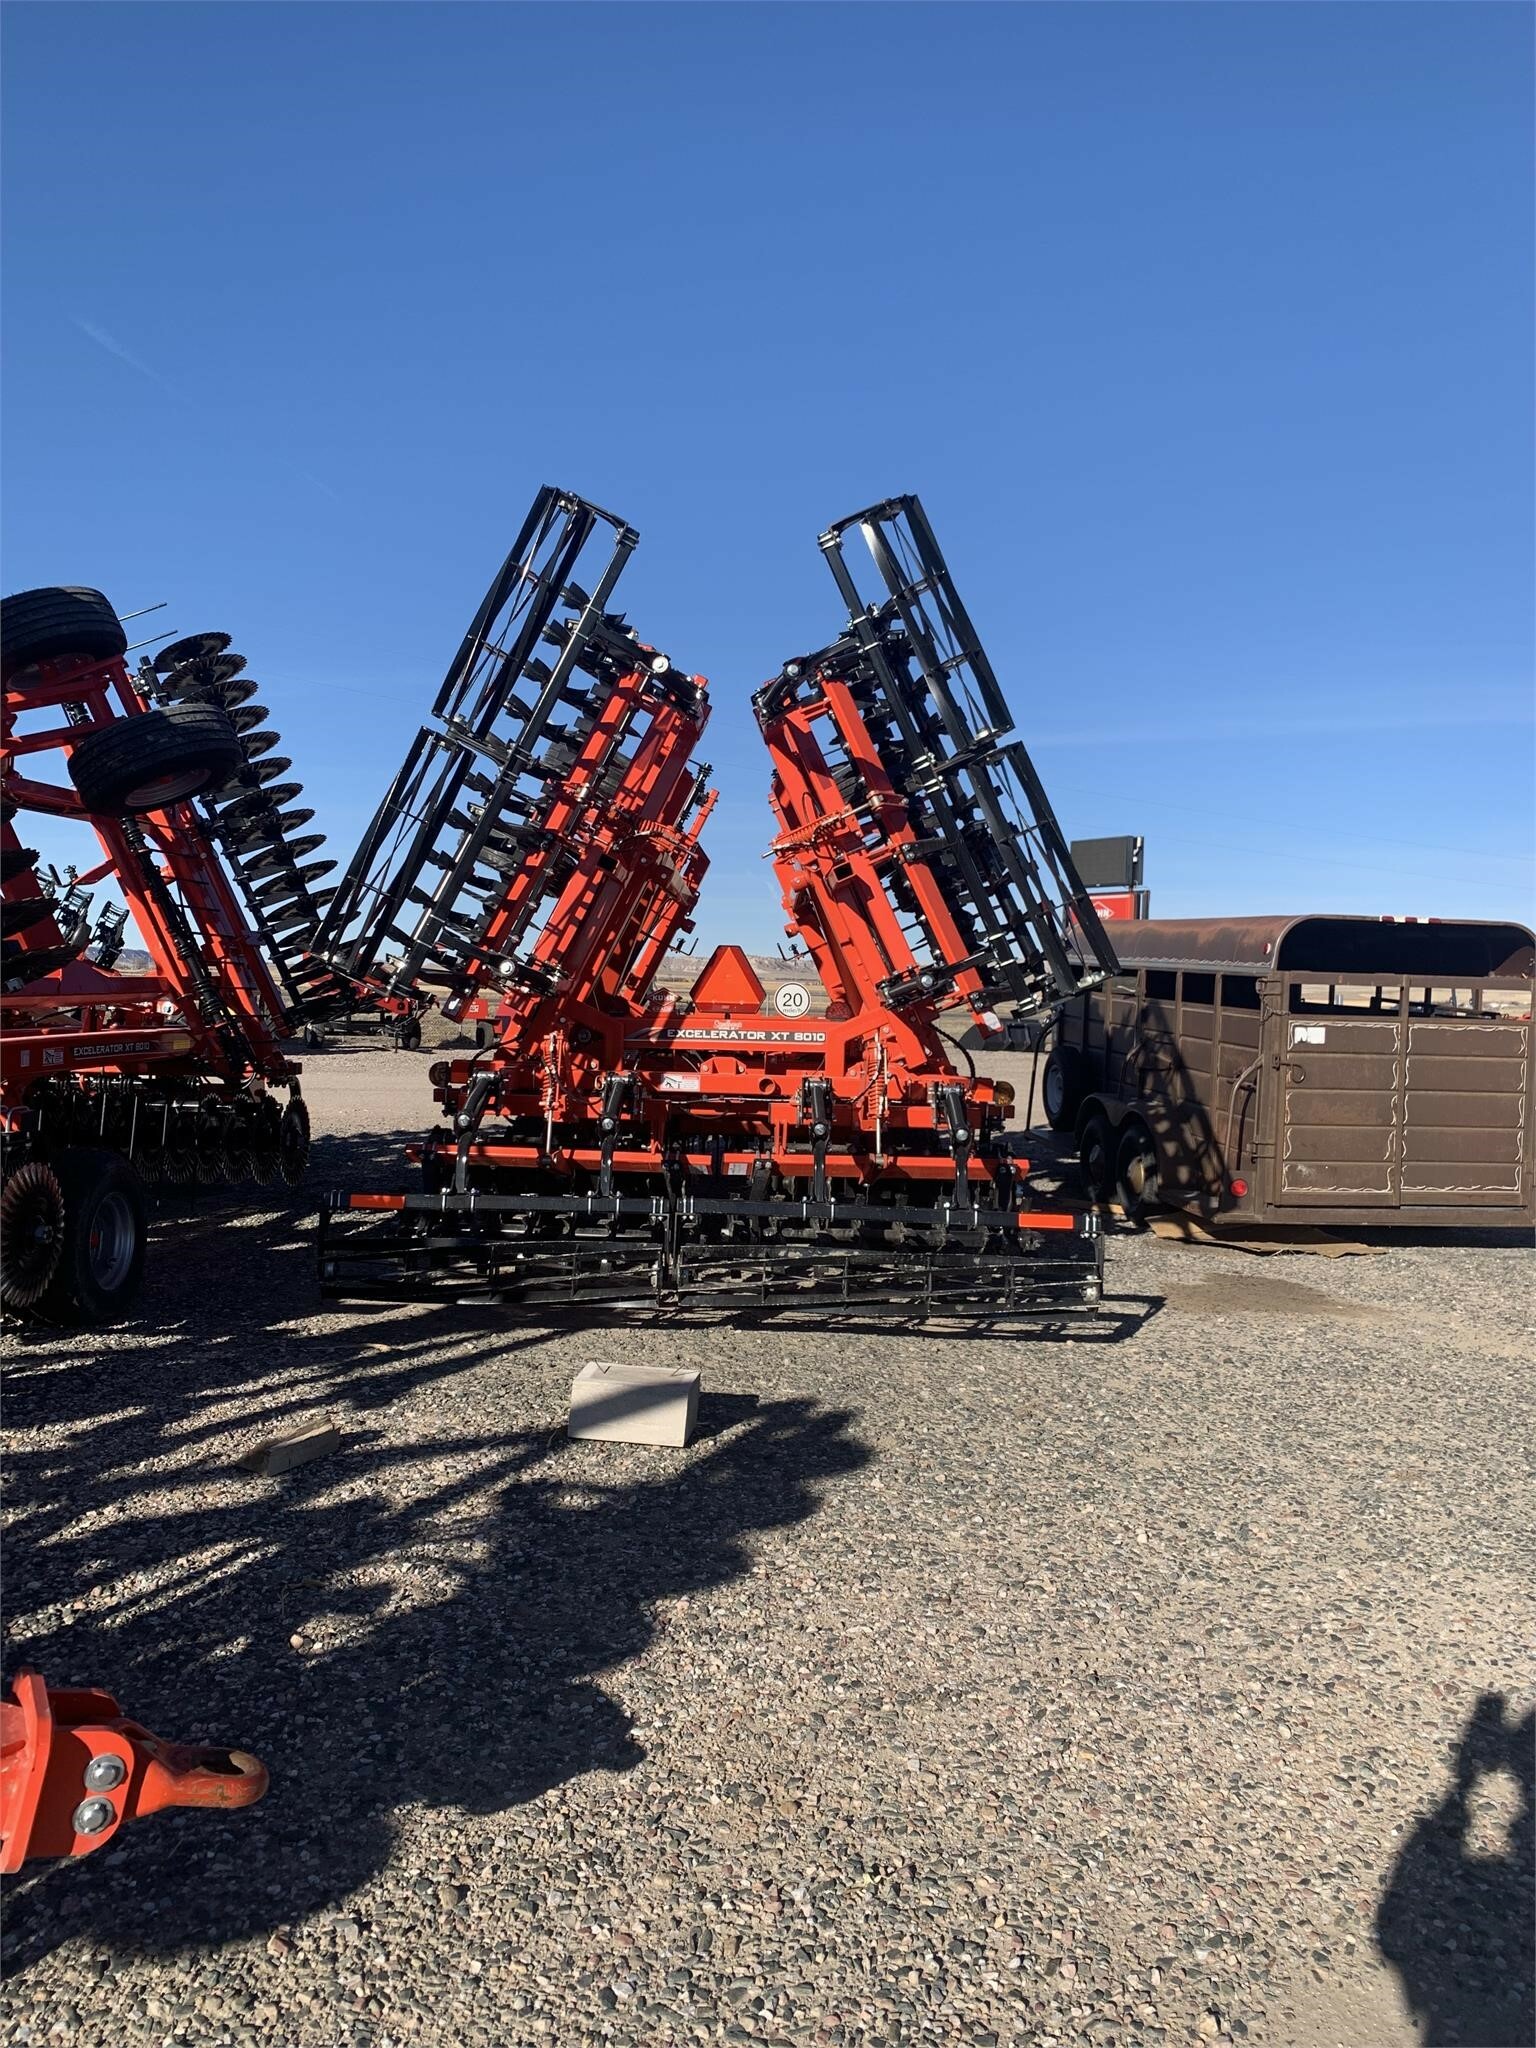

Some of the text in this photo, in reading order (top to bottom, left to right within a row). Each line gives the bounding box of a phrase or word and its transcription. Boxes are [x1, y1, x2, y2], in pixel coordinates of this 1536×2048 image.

[783, 992, 803, 1007] 20
[667, 1029, 826, 1042] EXCELERATOR XT 8010
[73, 1043, 124, 1057] EXCELERATOR
[125, 1042, 135, 1052] XT
